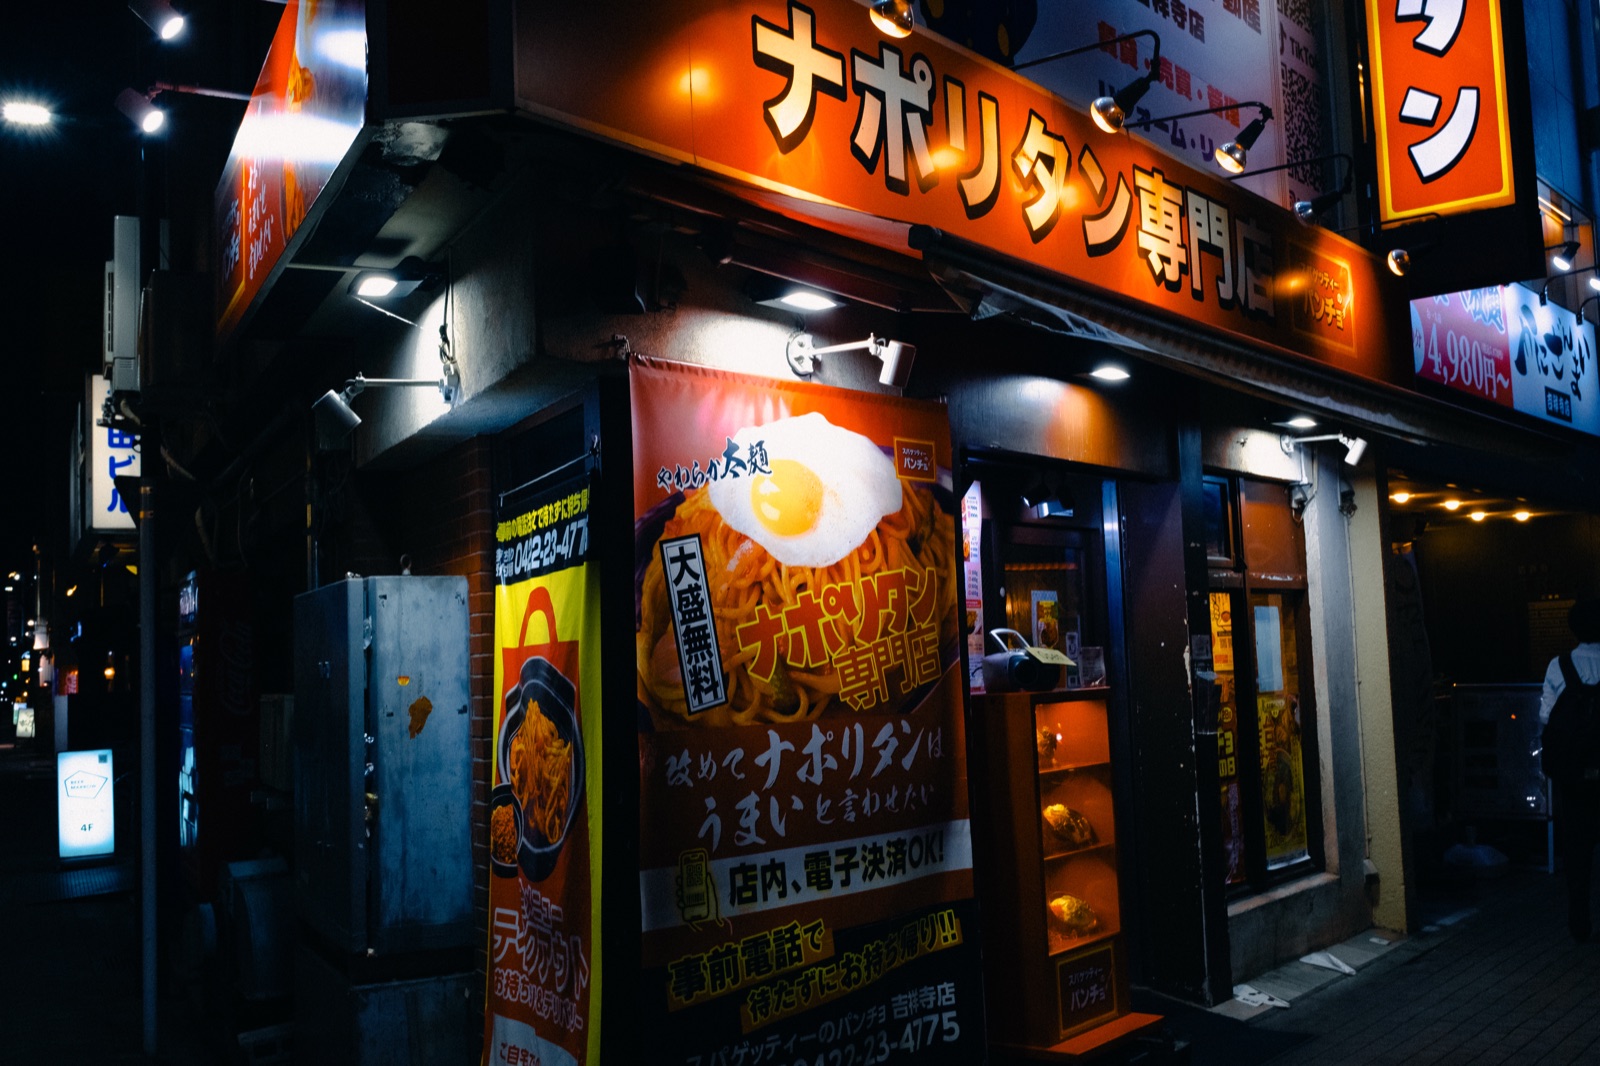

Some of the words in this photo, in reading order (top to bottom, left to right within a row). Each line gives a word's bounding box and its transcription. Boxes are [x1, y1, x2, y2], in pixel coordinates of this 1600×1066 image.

[752, 5, 1277, 319] ナポリタン専門店
[657, 437, 772, 494] やわらか太麺
[669, 546, 720, 704] 大盛無料
[737, 566, 937, 683] ナポリタン
[832, 623, 942, 711] 専門店
[665, 719, 945, 792] 改めてナポリタンは
[80, 823, 93, 832] 4F
[697, 784, 935, 854] うまいと言わせたい
[728, 829, 945, 908] 店内、電子決済OK!
[668, 918, 825, 1003] 事前電話で
[891, 982, 957, 1020] 吉祥寺店
